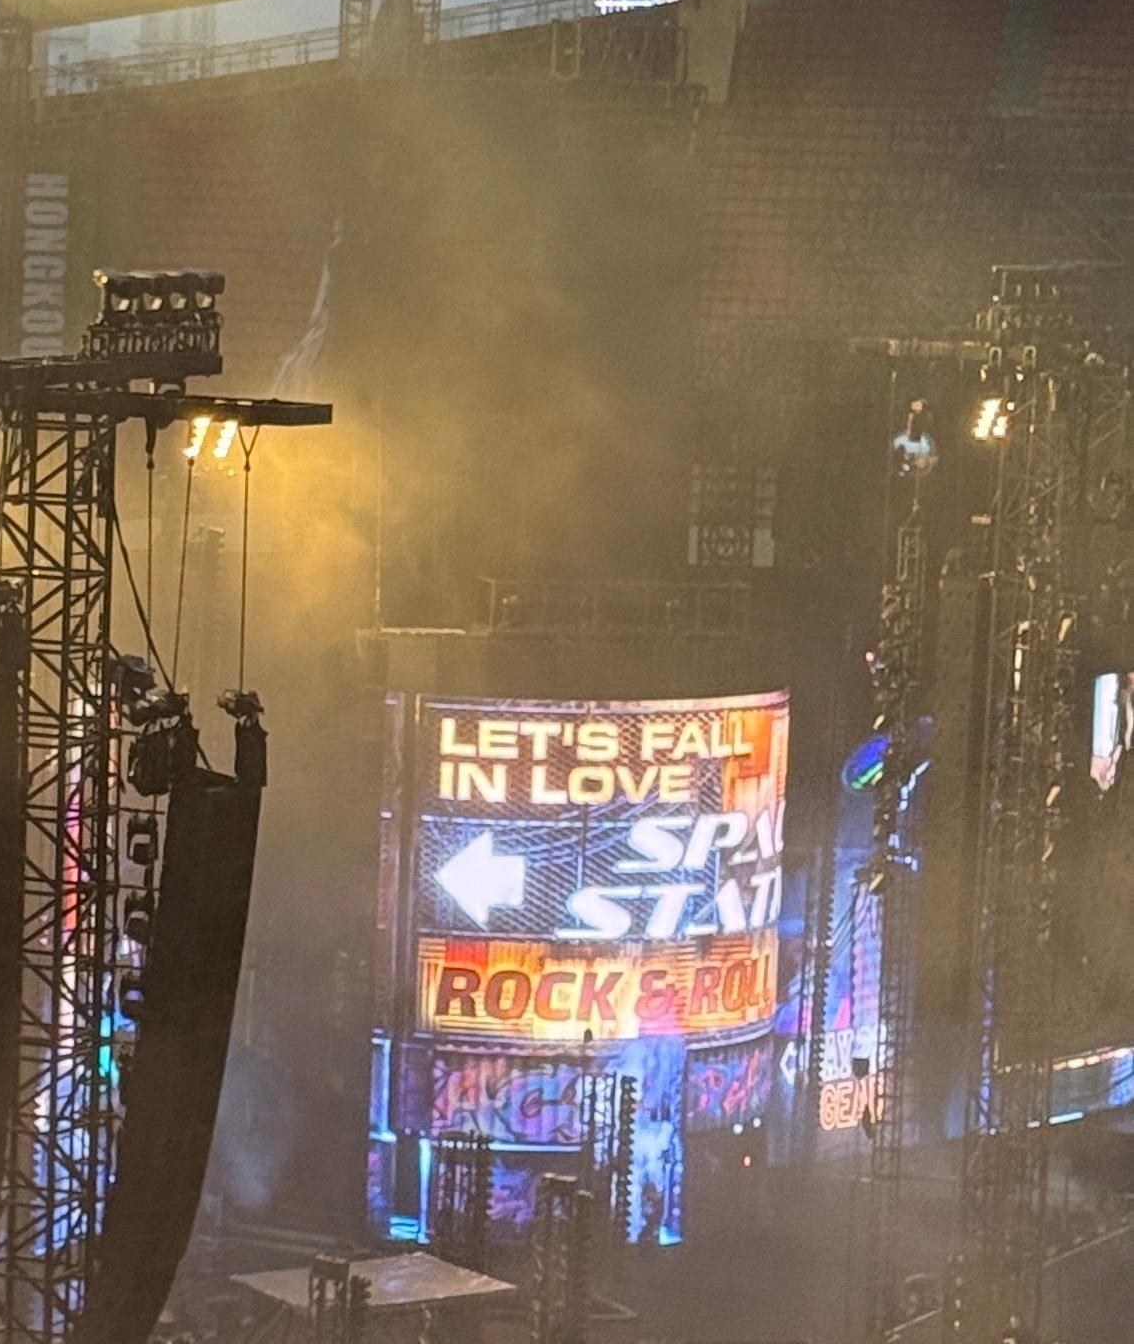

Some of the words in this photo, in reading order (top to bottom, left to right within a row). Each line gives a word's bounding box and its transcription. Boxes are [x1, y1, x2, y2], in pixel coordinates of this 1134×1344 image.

[439, 718, 619, 761] LET'S
[640, 716, 754, 761] FALL
[438, 762, 508, 804] IN
[531, 764, 693, 805] LOVE
[434, 966, 623, 1022] ROCK
[634, 969, 681, 1020] &
